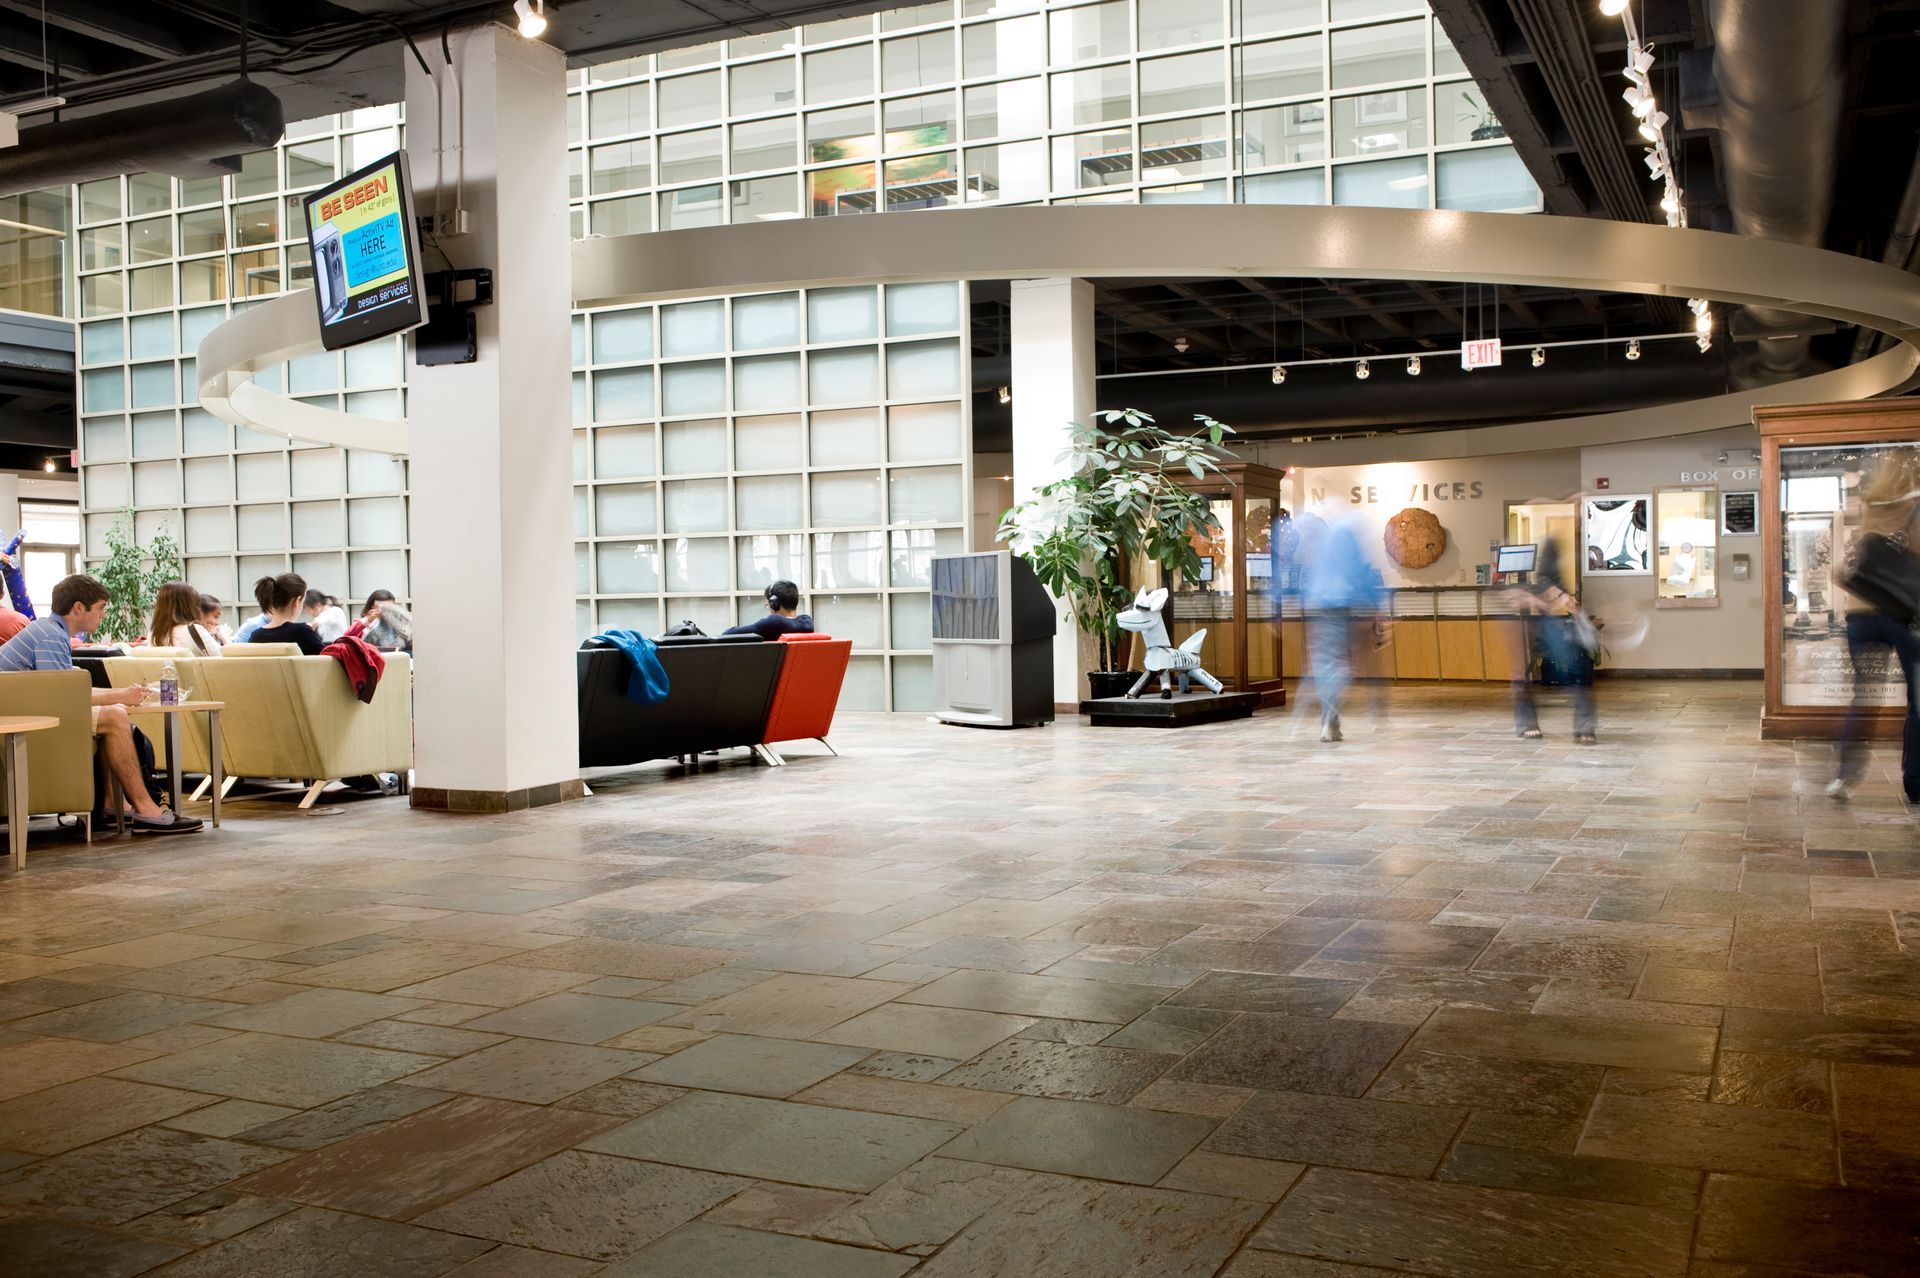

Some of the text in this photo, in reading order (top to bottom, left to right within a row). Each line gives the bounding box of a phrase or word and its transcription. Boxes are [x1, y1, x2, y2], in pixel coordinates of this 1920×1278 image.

[320, 175, 388, 221] BE SEEN
[360, 234, 387, 257] HERE
[1467, 342, 1496, 365] EXIT
[1680, 470, 1719, 482] BOX
[1350, 481, 1484, 504] SEVICES
[1816, 667, 1857, 675] CHAPEL
